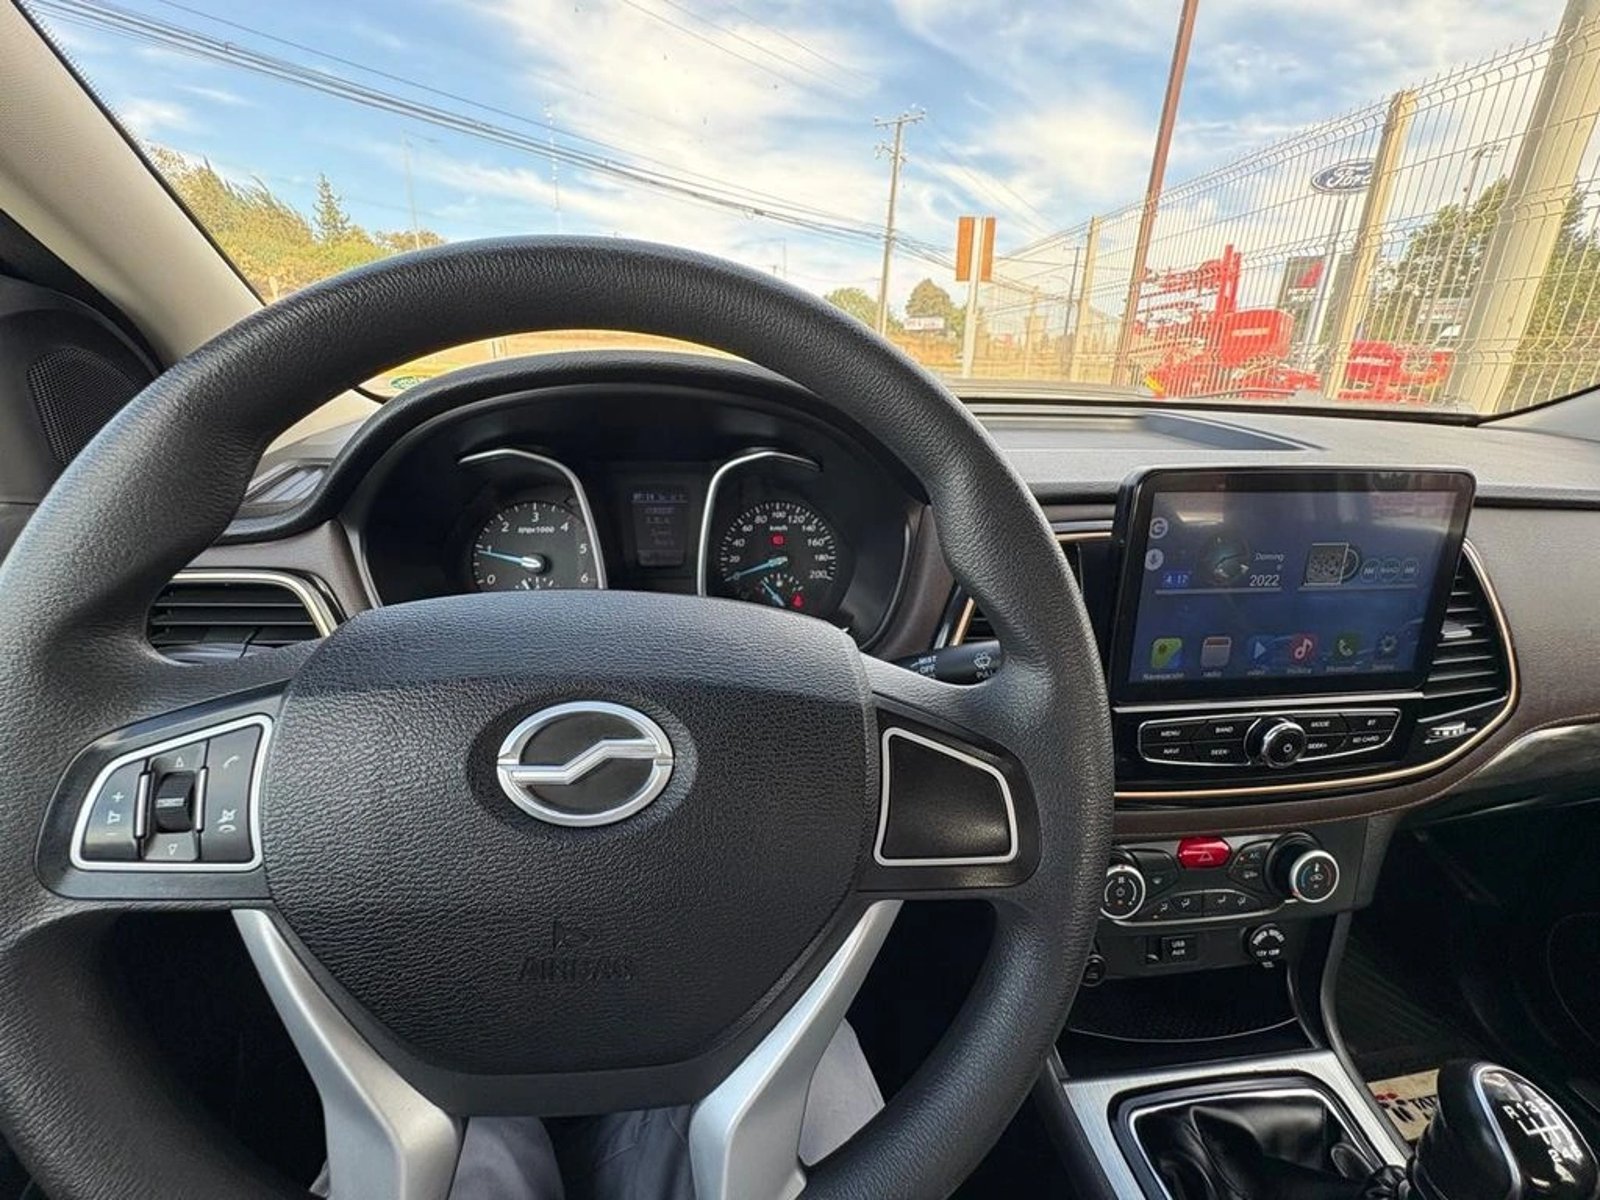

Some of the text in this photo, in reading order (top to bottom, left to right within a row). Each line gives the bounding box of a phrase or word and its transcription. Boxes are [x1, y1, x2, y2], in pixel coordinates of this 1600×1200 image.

[531, 512, 540, 522] 3
[754, 515, 768, 524] 80
[788, 515, 805, 524] 120
[501, 521, 510, 532] 2
[560, 522, 569, 532] 4
[732, 539, 746, 547] 40
[807, 539, 825, 547] 160
[580, 544, 588, 554] 5
[487, 574, 496, 585] 0
[581, 573, 589, 583] 6
[810, 570, 828, 579] 200
[1249, 574, 1281, 588] 2022
[1502, 1105, 1520, 1119] R
[1516, 1102, 1529, 1115] 1
[1525, 1101, 1541, 1113] 3
[1548, 1149, 1563, 1162] 2
